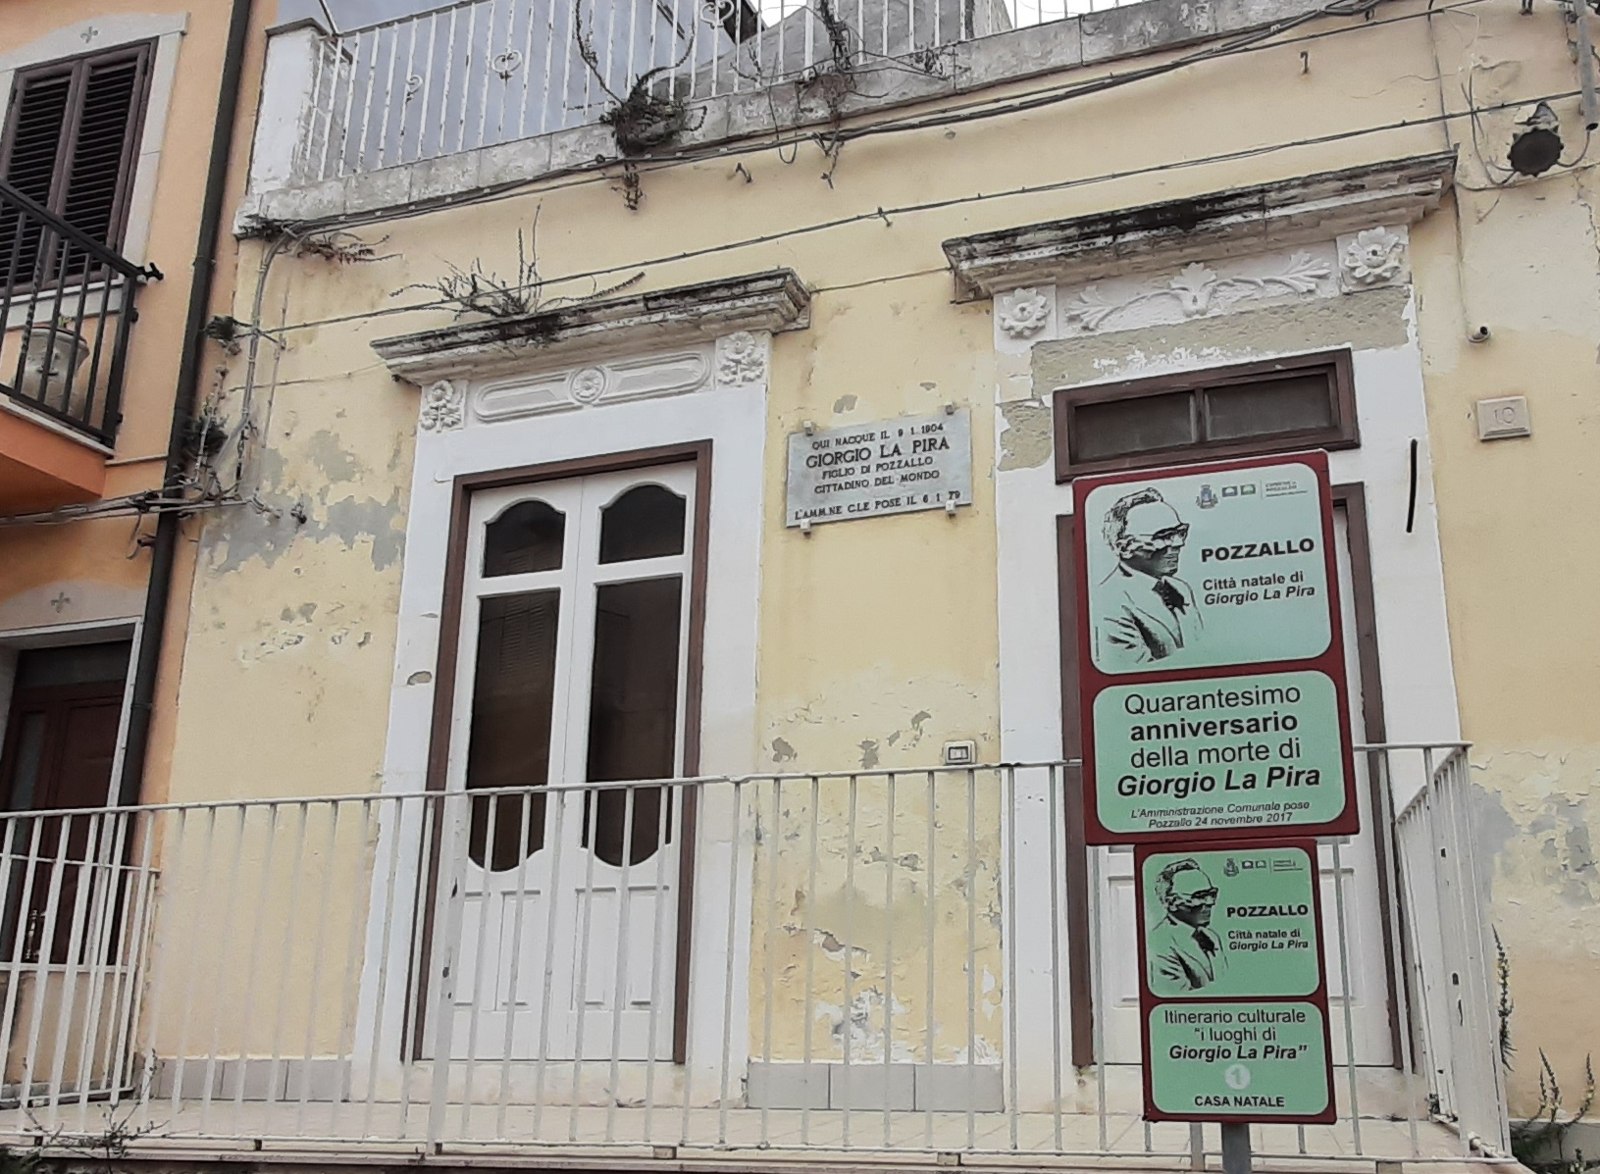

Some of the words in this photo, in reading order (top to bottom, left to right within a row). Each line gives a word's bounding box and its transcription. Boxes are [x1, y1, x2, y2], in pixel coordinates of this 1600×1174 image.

[812, 440, 830, 450] QUI
[835, 432, 875, 447] NACQUE
[881, 430, 890, 439] IL
[921, 423, 944, 433] 1904
[806, 447, 872, 469] GIORGIO
[880, 444, 902, 459] LA
[912, 436, 950, 454] PIRA
[822, 467, 855, 480] FIGLIO
[861, 465, 870, 474] DI
[875, 456, 933, 473] POZZALLO
[814, 477, 870, 494] CITTADINO
[874, 477, 894, 487] DEL
[901, 470, 940, 483] MONDO
[875, 496, 901, 510] POSE
[906, 495, 916, 505] IL
[922, 494, 928, 503] 6
[936, 492, 940, 501] 1
[948, 490, 961, 499] 79
[1201, 538, 1314, 562] POZZALLO
[1203, 577, 1236, 591] Città
[1241, 573, 1285, 587] natale
[1290, 571, 1304, 582] di
[1204, 590, 1258, 605] Giorgio
[1263, 589, 1280, 600] La
[1286, 585, 1315, 598] Pira
[1125, 686, 1301, 715] Quarantesimo
[1130, 711, 1298, 741] anniversario
[1130, 746, 1188, 768] della
[1198, 741, 1270, 764] morte
[1279, 738, 1301, 759] di
[1118, 772, 1216, 799] Giorgio
[1225, 770, 1257, 790] La
[1266, 766, 1321, 788] Pira
[1131, 805, 1224, 819] L'Amministrazione
[1227, 802, 1280, 813] Comunale
[1283, 801, 1310, 812] pose
[1148, 817, 1192, 829] Pozzallo
[1195, 817, 1208, 826] 24
[1211, 814, 1263, 825] novembre
[1266, 812, 1293, 823] 2017
[1227, 904, 1308, 918] POZZALLO
[1228, 930, 1252, 940] Città
[1256, 929, 1287, 939] natale
[1290, 928, 1300, 938] di
[1229, 941, 1268, 951] Giorgio
[1271, 941, 1284, 949] La
[1288, 940, 1308, 949] Pira
[1165, 1010, 1232, 1024] Itinerario
[1238, 1009, 1306, 1023] culturale
[1210, 1027, 1257, 1044] luoghi
[1262, 1027, 1276, 1040] di
[1169, 1045, 1232, 1062] Giorgio
[1237, 1045, 1257, 1059] La
[1231, 1067, 1242, 1085] 1
[1194, 1096, 1230, 1106] CASA
[1234, 1097, 1285, 1107] NATALE
